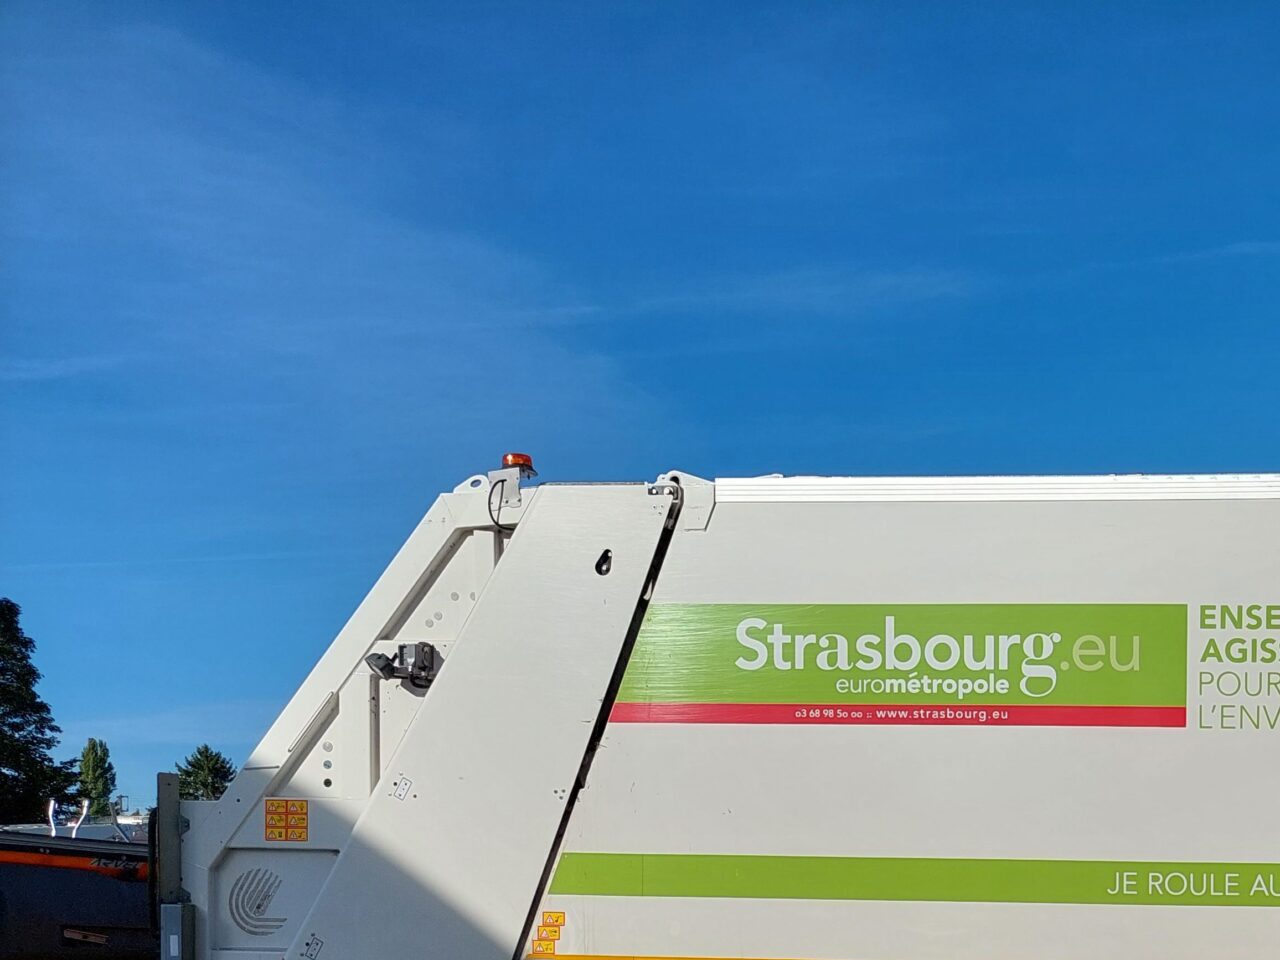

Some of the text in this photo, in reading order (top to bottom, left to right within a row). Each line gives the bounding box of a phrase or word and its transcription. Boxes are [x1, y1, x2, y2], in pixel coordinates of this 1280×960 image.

[734, 615, 1141, 698] Strasbourg.eu
[835, 671, 1010, 699] eurométropole
[809, 708, 821, 718] 68
[823, 708, 834, 718] 98
[875, 708, 1009, 722] www.strasbourg.eu
[1106, 871, 1138, 895] JE
[1148, 872, 1240, 897] ROULE
